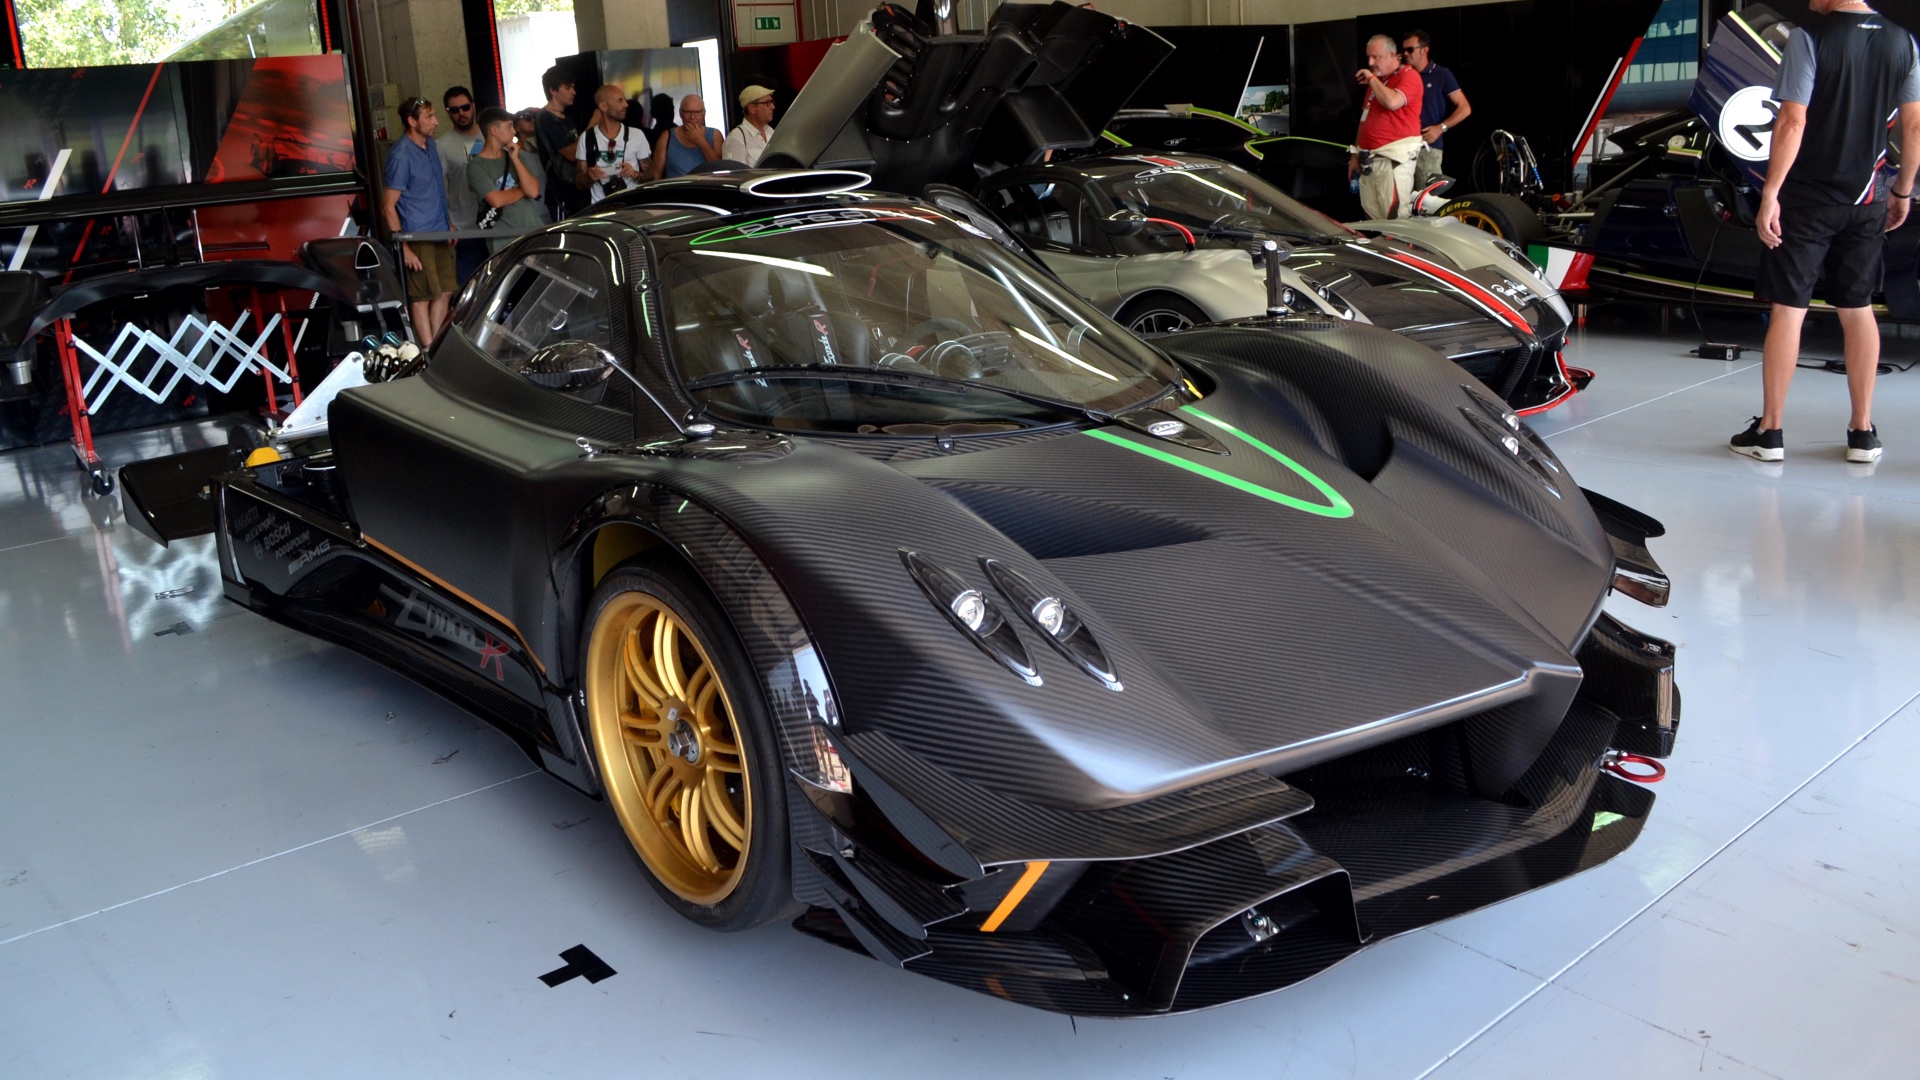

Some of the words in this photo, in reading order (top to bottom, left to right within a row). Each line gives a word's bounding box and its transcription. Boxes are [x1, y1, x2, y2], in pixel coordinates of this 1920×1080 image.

[1733, 100, 1781, 151] 2
[1439, 201, 1472, 218] ZERO
[263, 521, 292, 550] BOSCH
[299, 538, 331, 567] AMG
[478, 632, 511, 682] R
